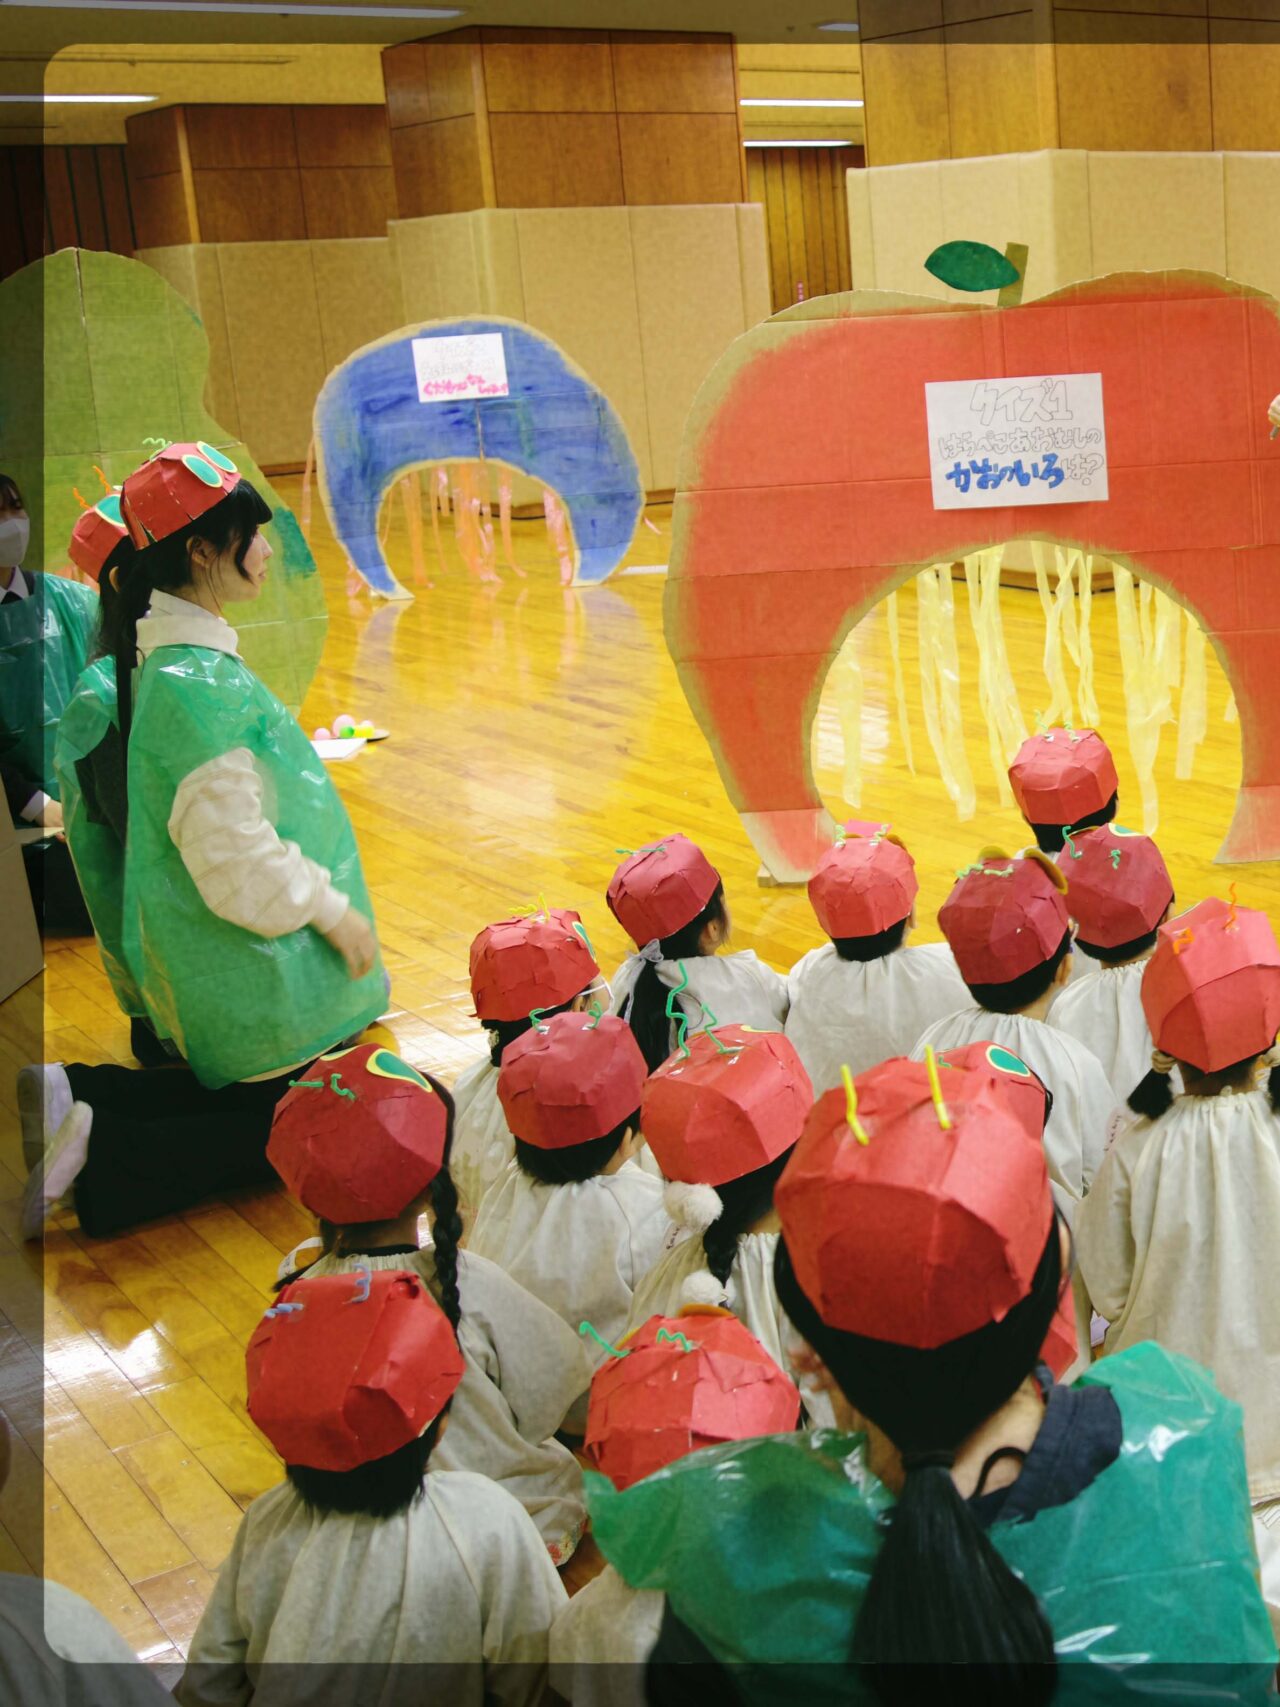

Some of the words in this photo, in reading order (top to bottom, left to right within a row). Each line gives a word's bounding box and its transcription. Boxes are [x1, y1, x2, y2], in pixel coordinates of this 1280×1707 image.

[971, 379, 1073, 426] クイズ1
[940, 428, 1102, 459] はらぺこあおむしの
[946, 453, 1104, 493] かおのいろは?
